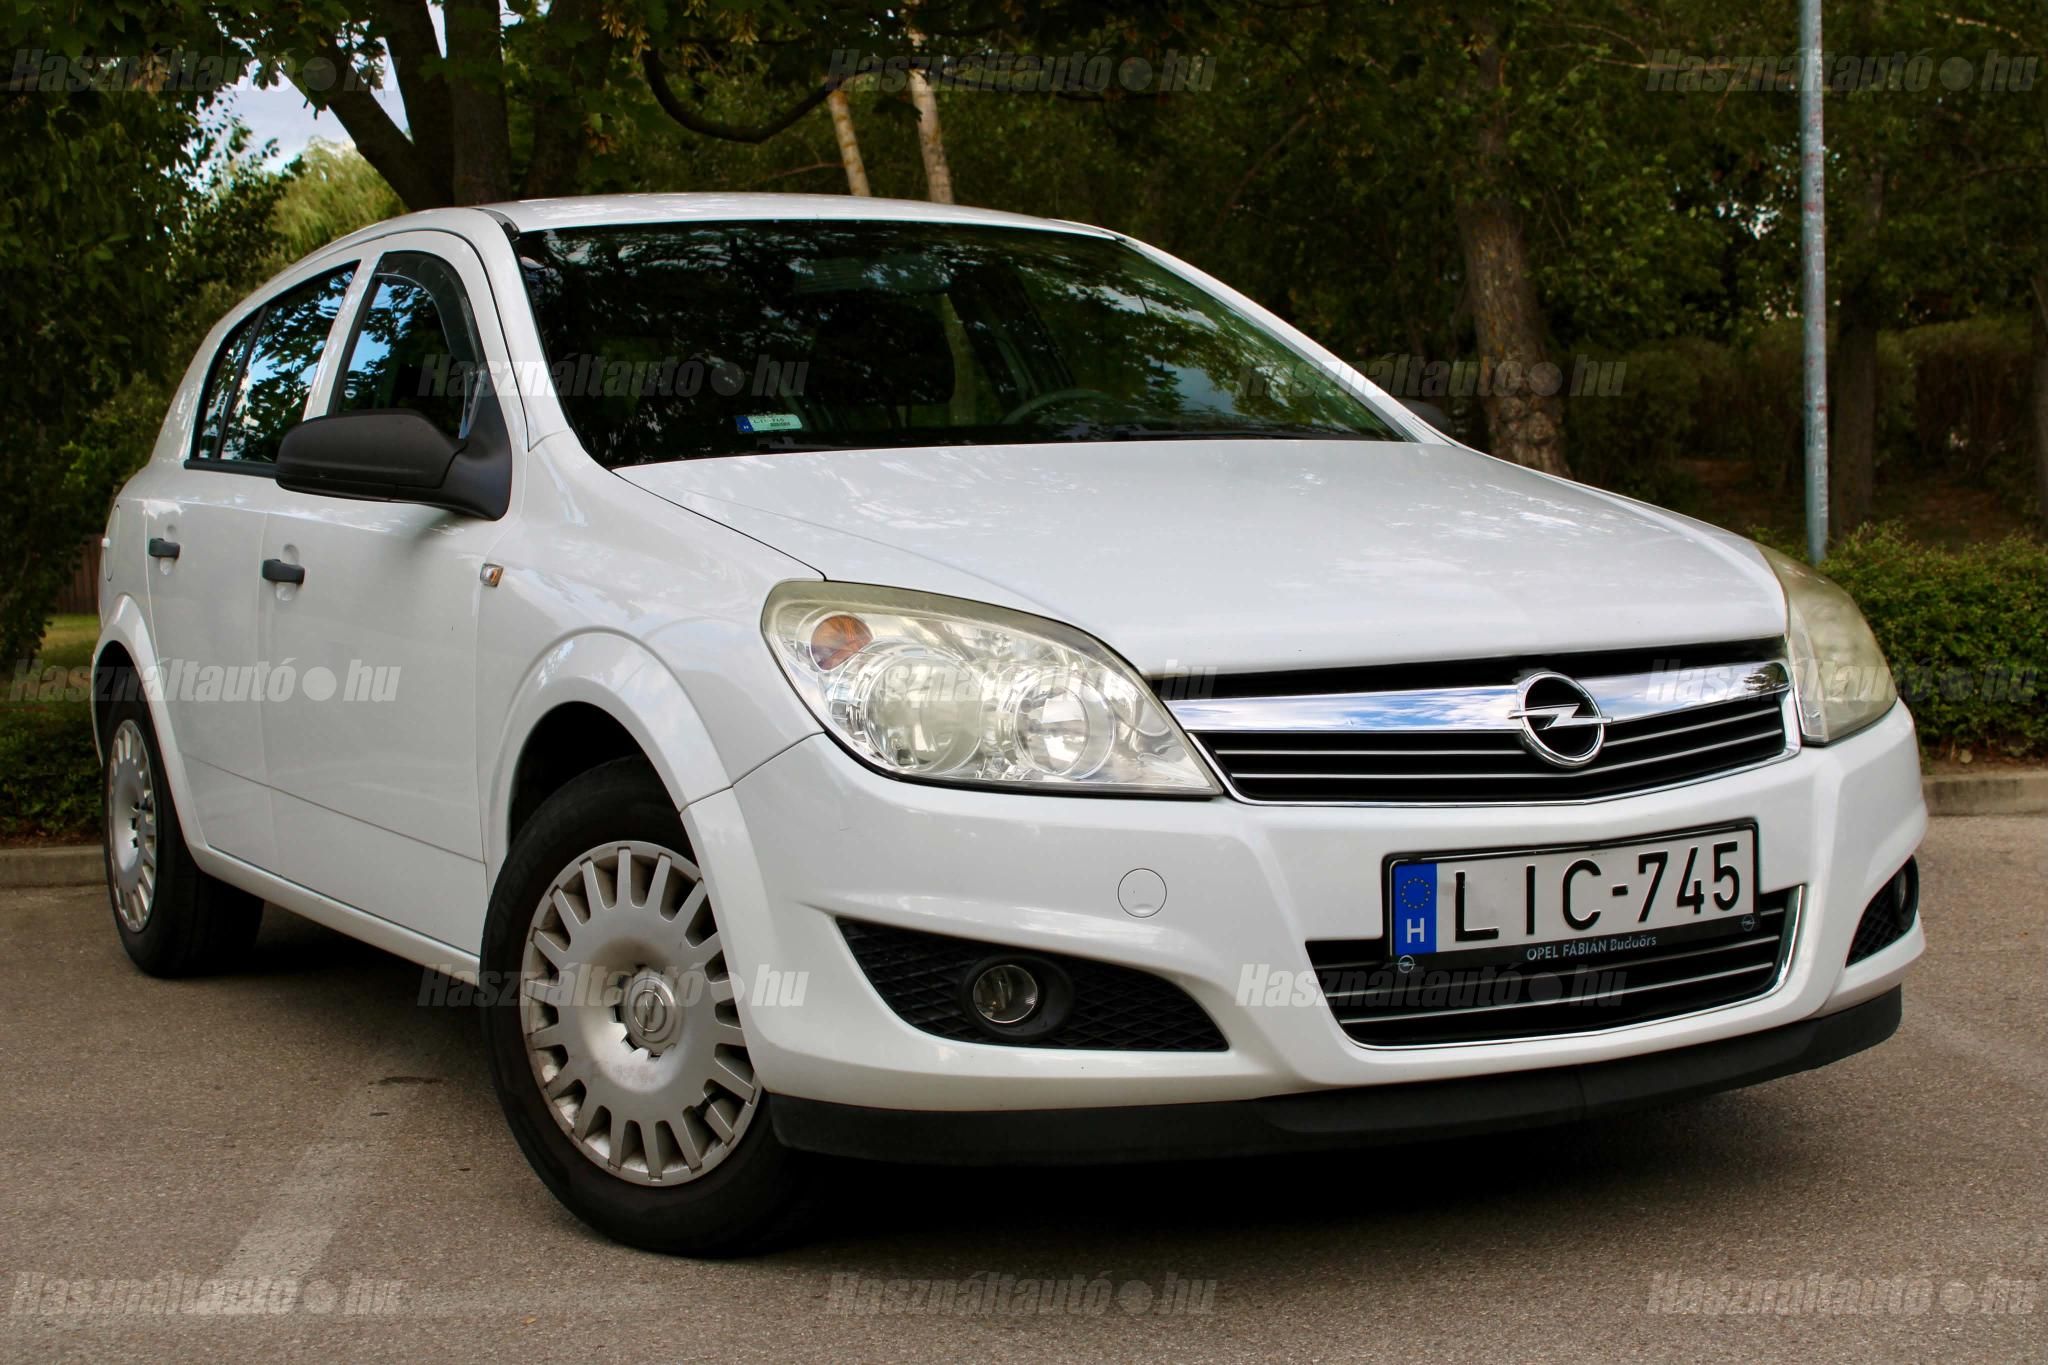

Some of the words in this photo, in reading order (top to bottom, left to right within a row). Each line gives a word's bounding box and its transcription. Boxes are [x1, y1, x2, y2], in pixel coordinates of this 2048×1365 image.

[1455, 841, 1740, 942] LIC-745
[1406, 918, 1425, 944] H
[1526, 946, 1559, 961] OPEL
[1562, 940, 1607, 957] FÁBIÁN
